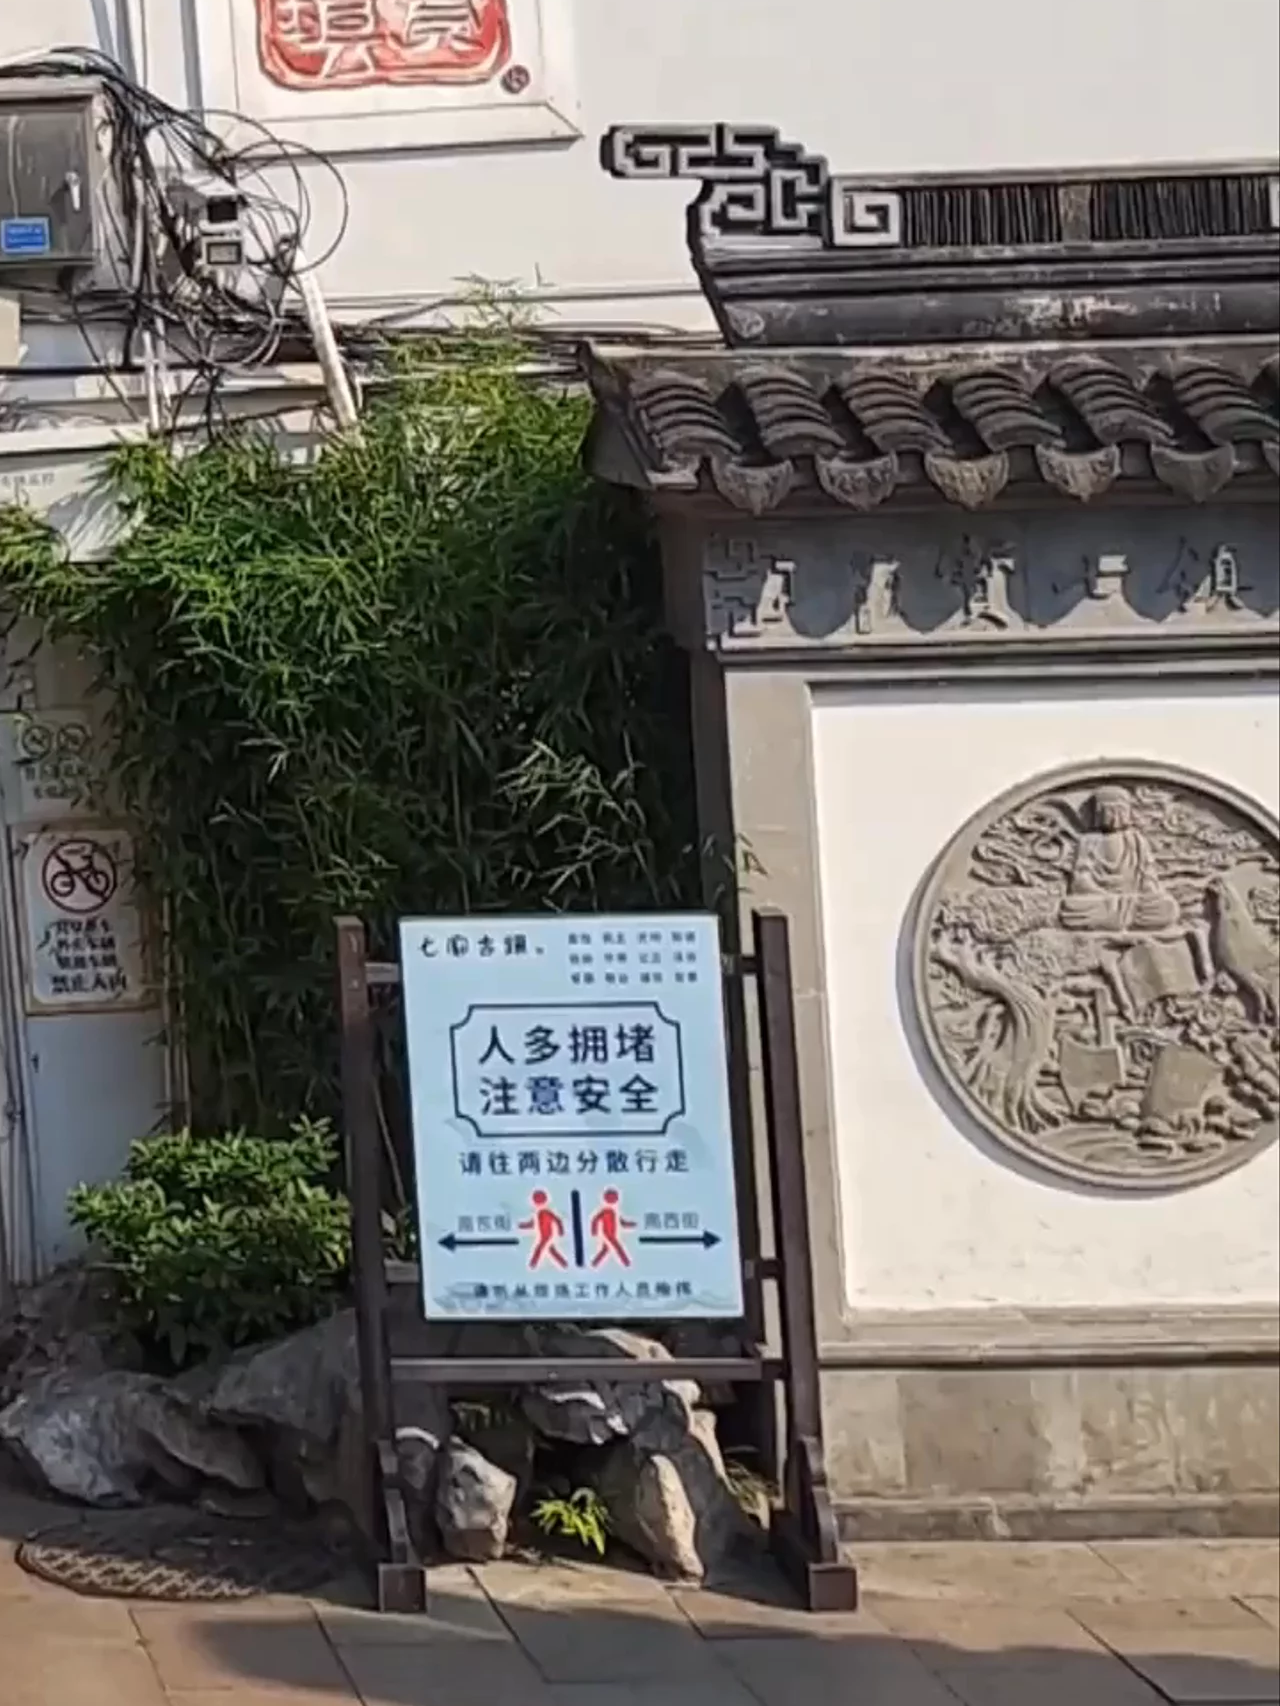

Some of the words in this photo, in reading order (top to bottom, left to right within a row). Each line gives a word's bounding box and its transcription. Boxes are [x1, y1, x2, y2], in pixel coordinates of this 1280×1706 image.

[477, 1024, 656, 1066] 人多拥堵
[479, 1073, 659, 1117] 注意安全
[458, 1149, 690, 1176] 请往两边分散行走
